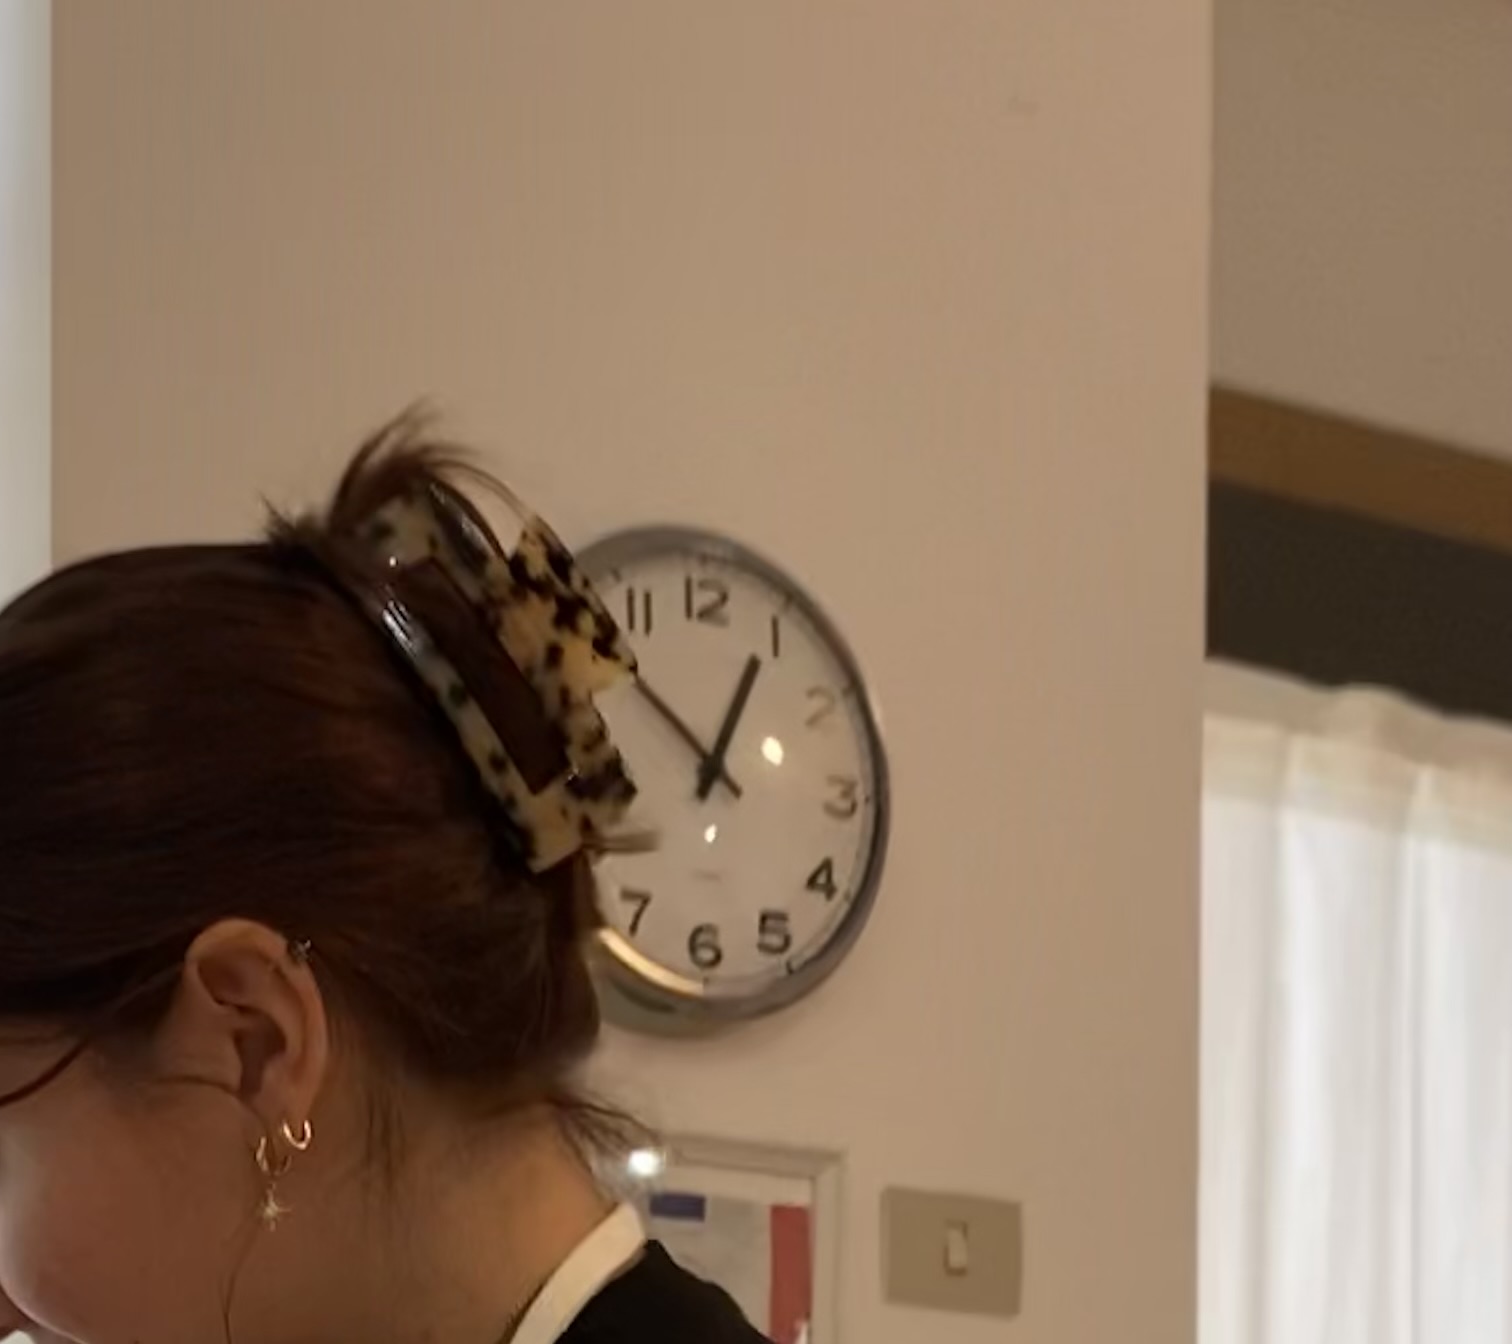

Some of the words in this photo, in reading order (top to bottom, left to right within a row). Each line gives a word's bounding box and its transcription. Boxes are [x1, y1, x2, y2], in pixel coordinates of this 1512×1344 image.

[626, 585, 653, 637] 11
[685, 575, 730, 628] 12
[770, 614, 781, 658] 1
[804, 685, 838, 737] 2
[822, 773, 859, 822] 3
[805, 856, 838, 901] 4
[619, 885, 652, 938] 7
[757, 908, 792, 956] 5
[687, 922, 723, 971] 6
